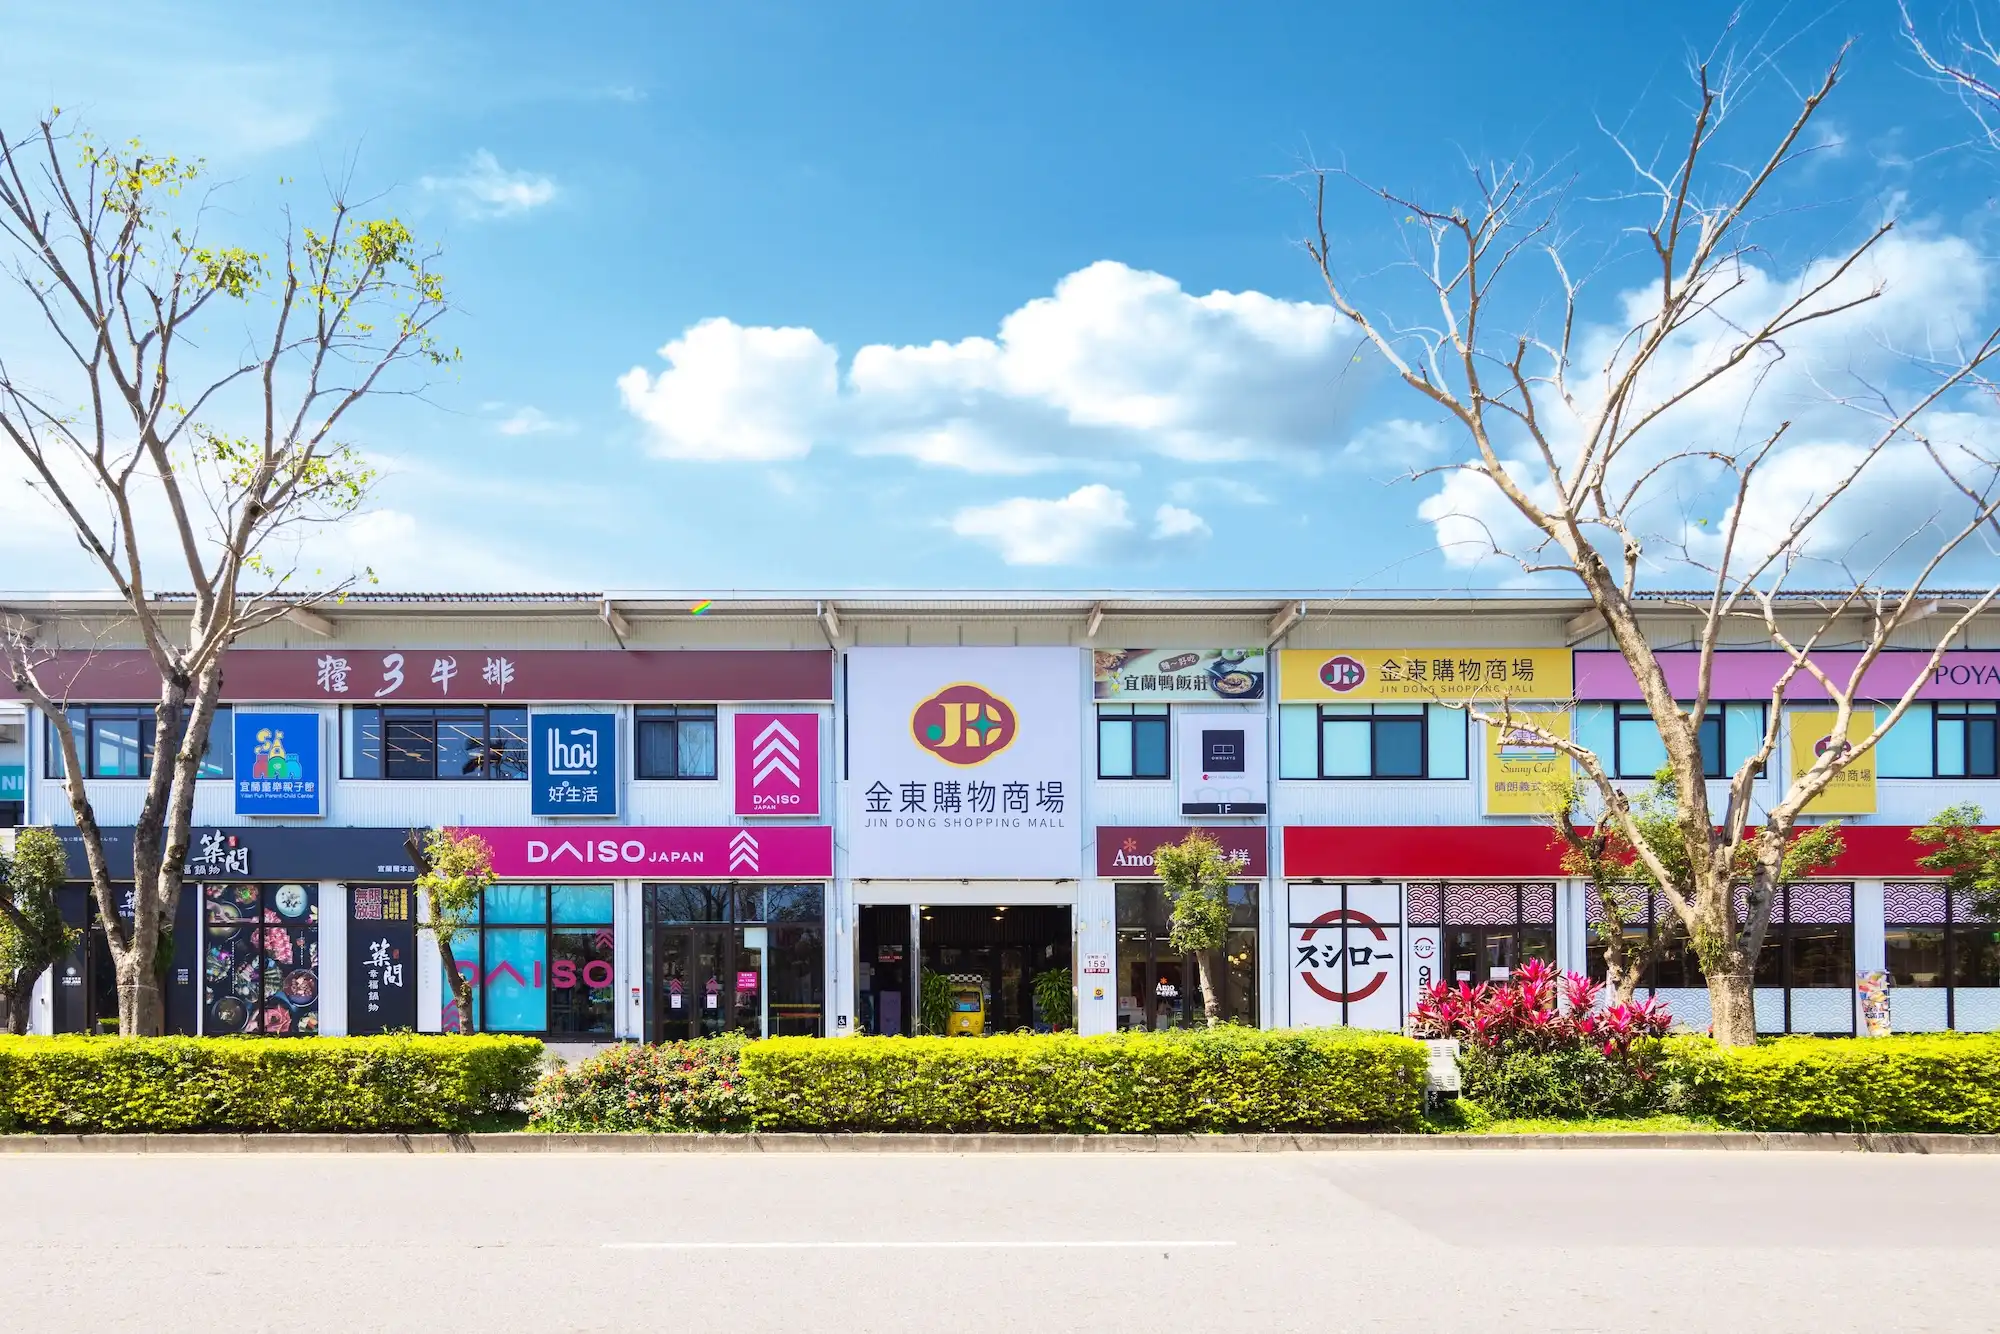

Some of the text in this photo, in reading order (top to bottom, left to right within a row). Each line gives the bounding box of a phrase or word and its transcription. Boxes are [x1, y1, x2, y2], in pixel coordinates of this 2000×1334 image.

[1380, 658, 1534, 682] 金東購物商場
[1935, 665, 2000, 685] POYA
[1124, 674, 1209, 691] 宜蘭鴨飯莊
[1380, 685, 1398, 693] JIN
[1403, 685, 1435, 693] DONG
[1441, 685, 1500, 693] SHOPPING
[1501, 763, 1531, 776] Sunny
[753, 795, 800, 805] DAISO
[865, 780, 1065, 814] 金東購物商場
[1217, 804, 1232, 814] 1F
[865, 817, 1065, 828] JIN DONG SHOPPING MALL
[527, 841, 704, 863] DAISO JAPAN
[1113, 848, 1154, 867] Amo
[1088, 960, 1105, 968] 159
[1295, 945, 1394, 968] スシロー
